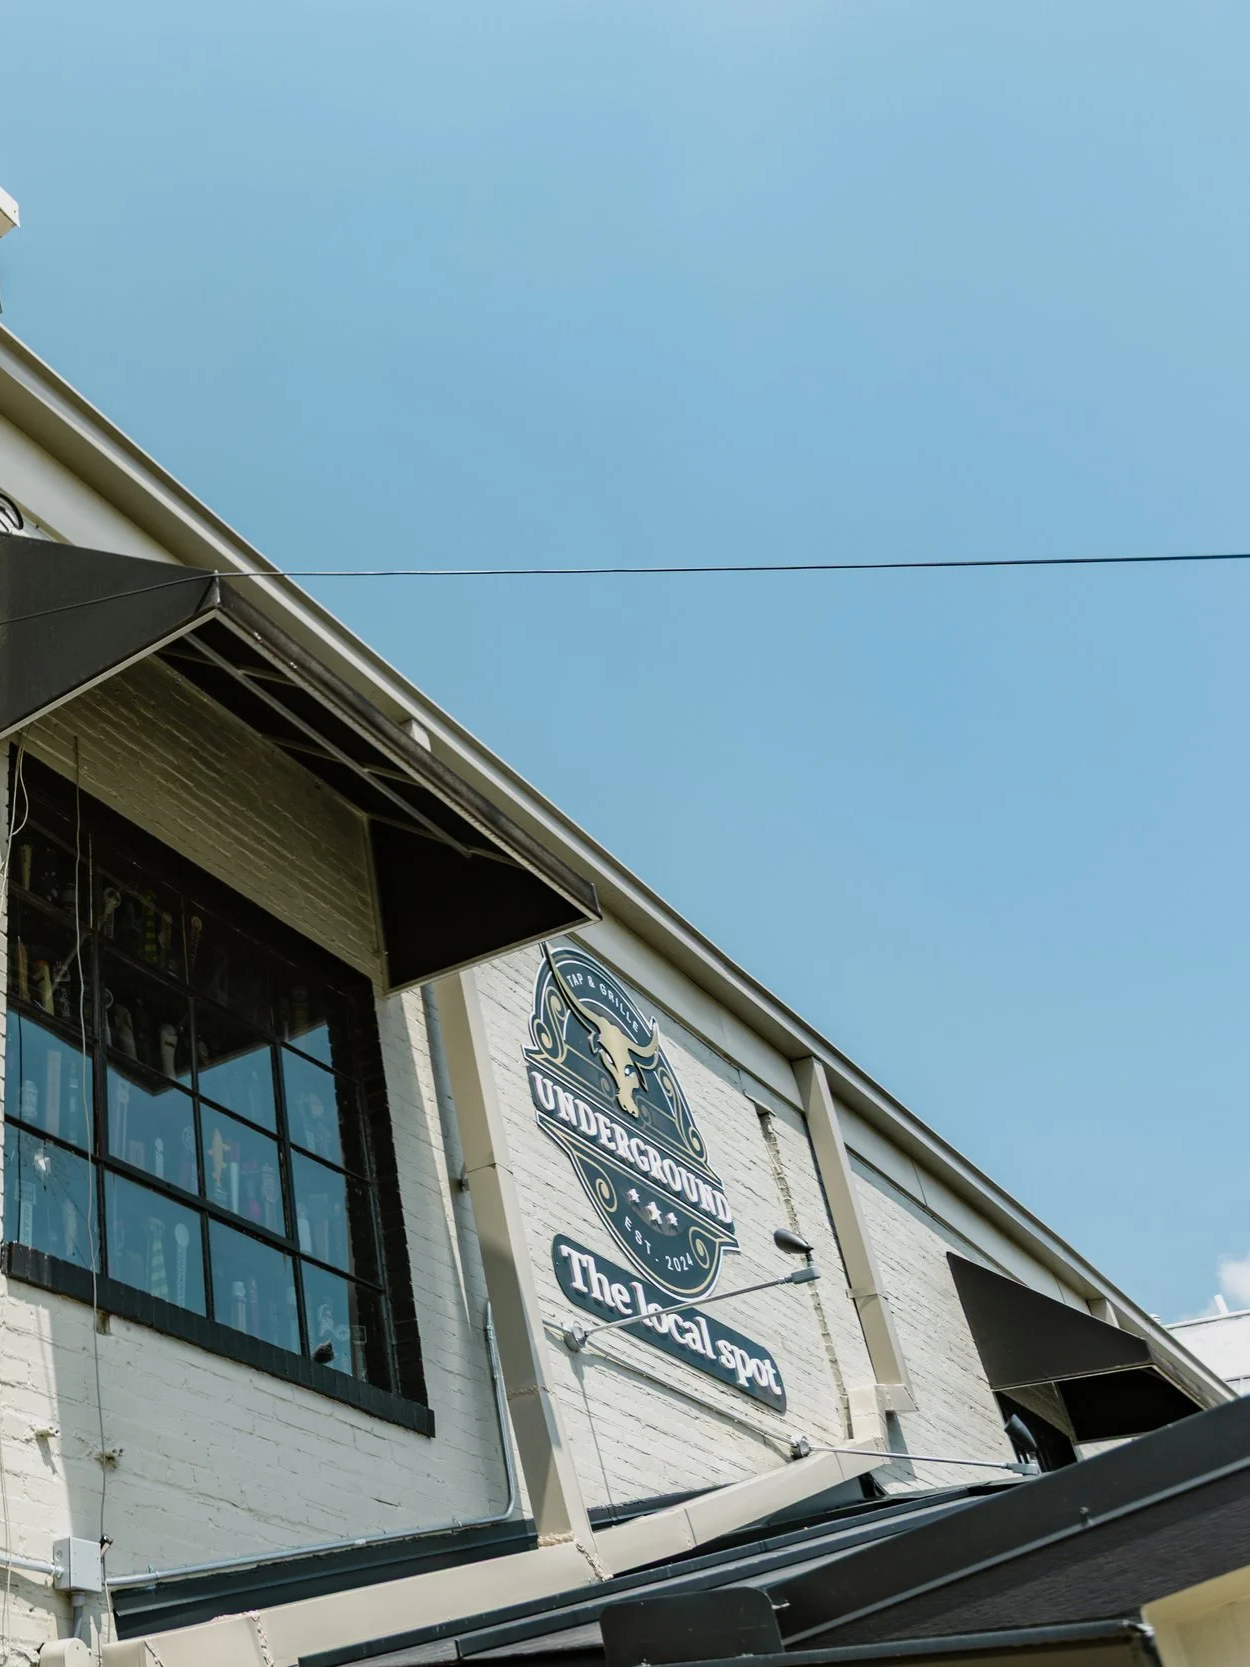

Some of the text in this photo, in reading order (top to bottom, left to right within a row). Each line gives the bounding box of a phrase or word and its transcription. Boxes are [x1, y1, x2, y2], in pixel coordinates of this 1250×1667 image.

[566, 973, 639, 1033] TAP & GRILLE
[531, 1071, 733, 1223] UNDERGROUND
[665, 1252, 694, 1272] 2024
[558, 1244, 783, 1396] The local spot
